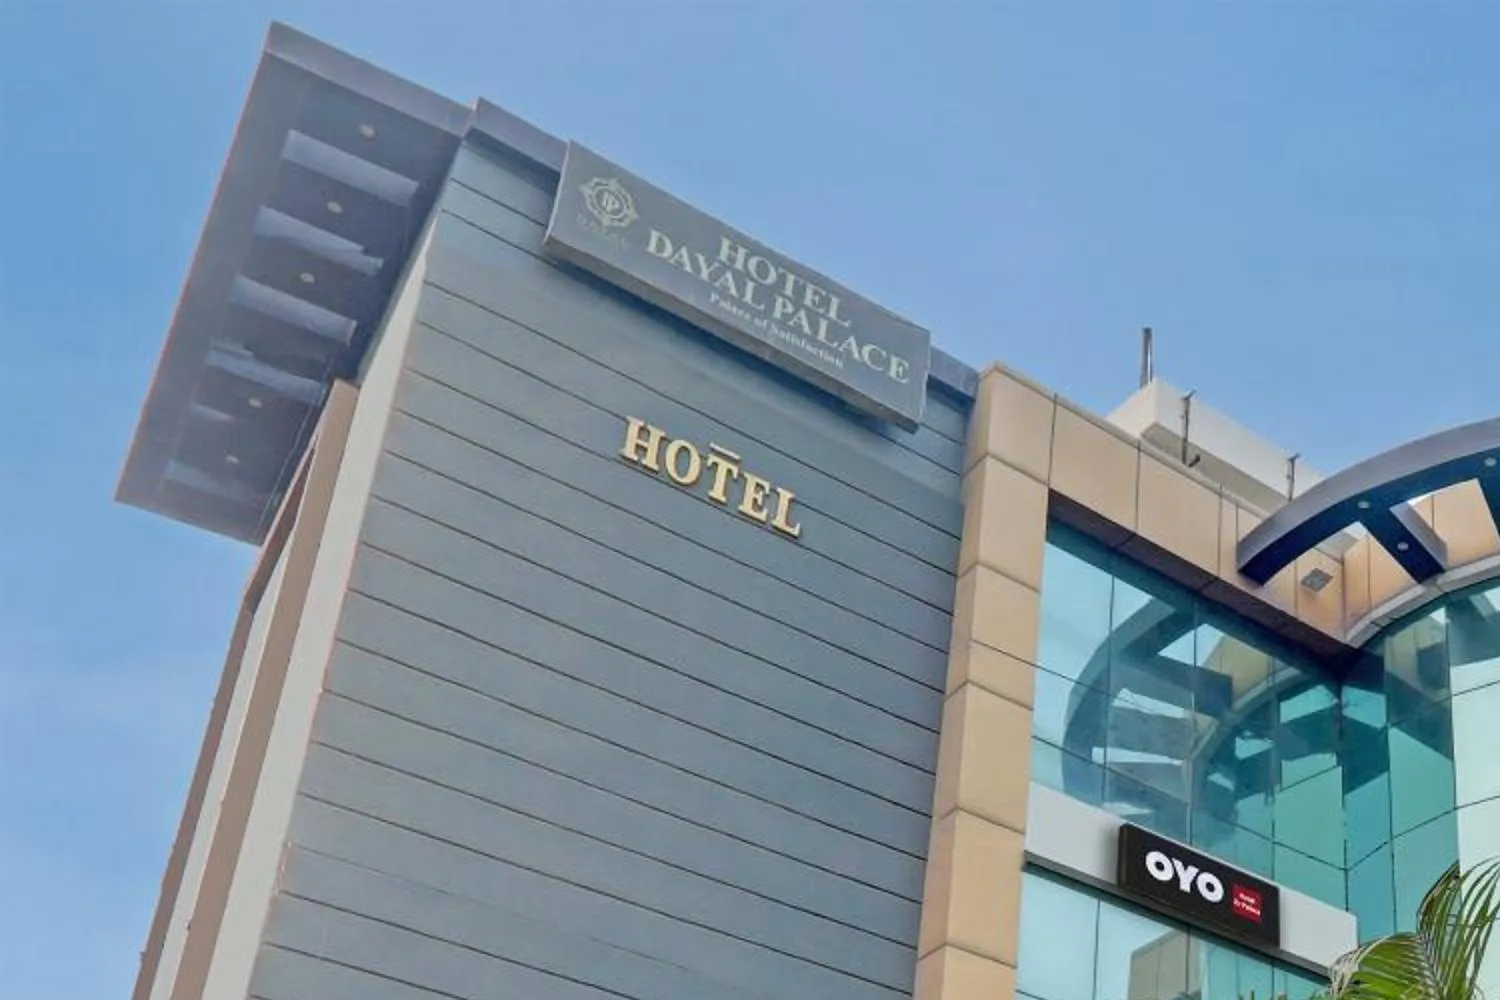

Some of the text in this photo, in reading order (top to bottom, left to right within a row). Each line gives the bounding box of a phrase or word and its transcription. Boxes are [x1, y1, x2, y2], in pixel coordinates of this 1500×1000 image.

[645, 229, 766, 316] DAYAL
[773, 296, 910, 385] PALACE
[718, 236, 851, 327] HOTEL
[620, 415, 802, 537] HOTEL
[1145, 851, 1225, 903] OYO
